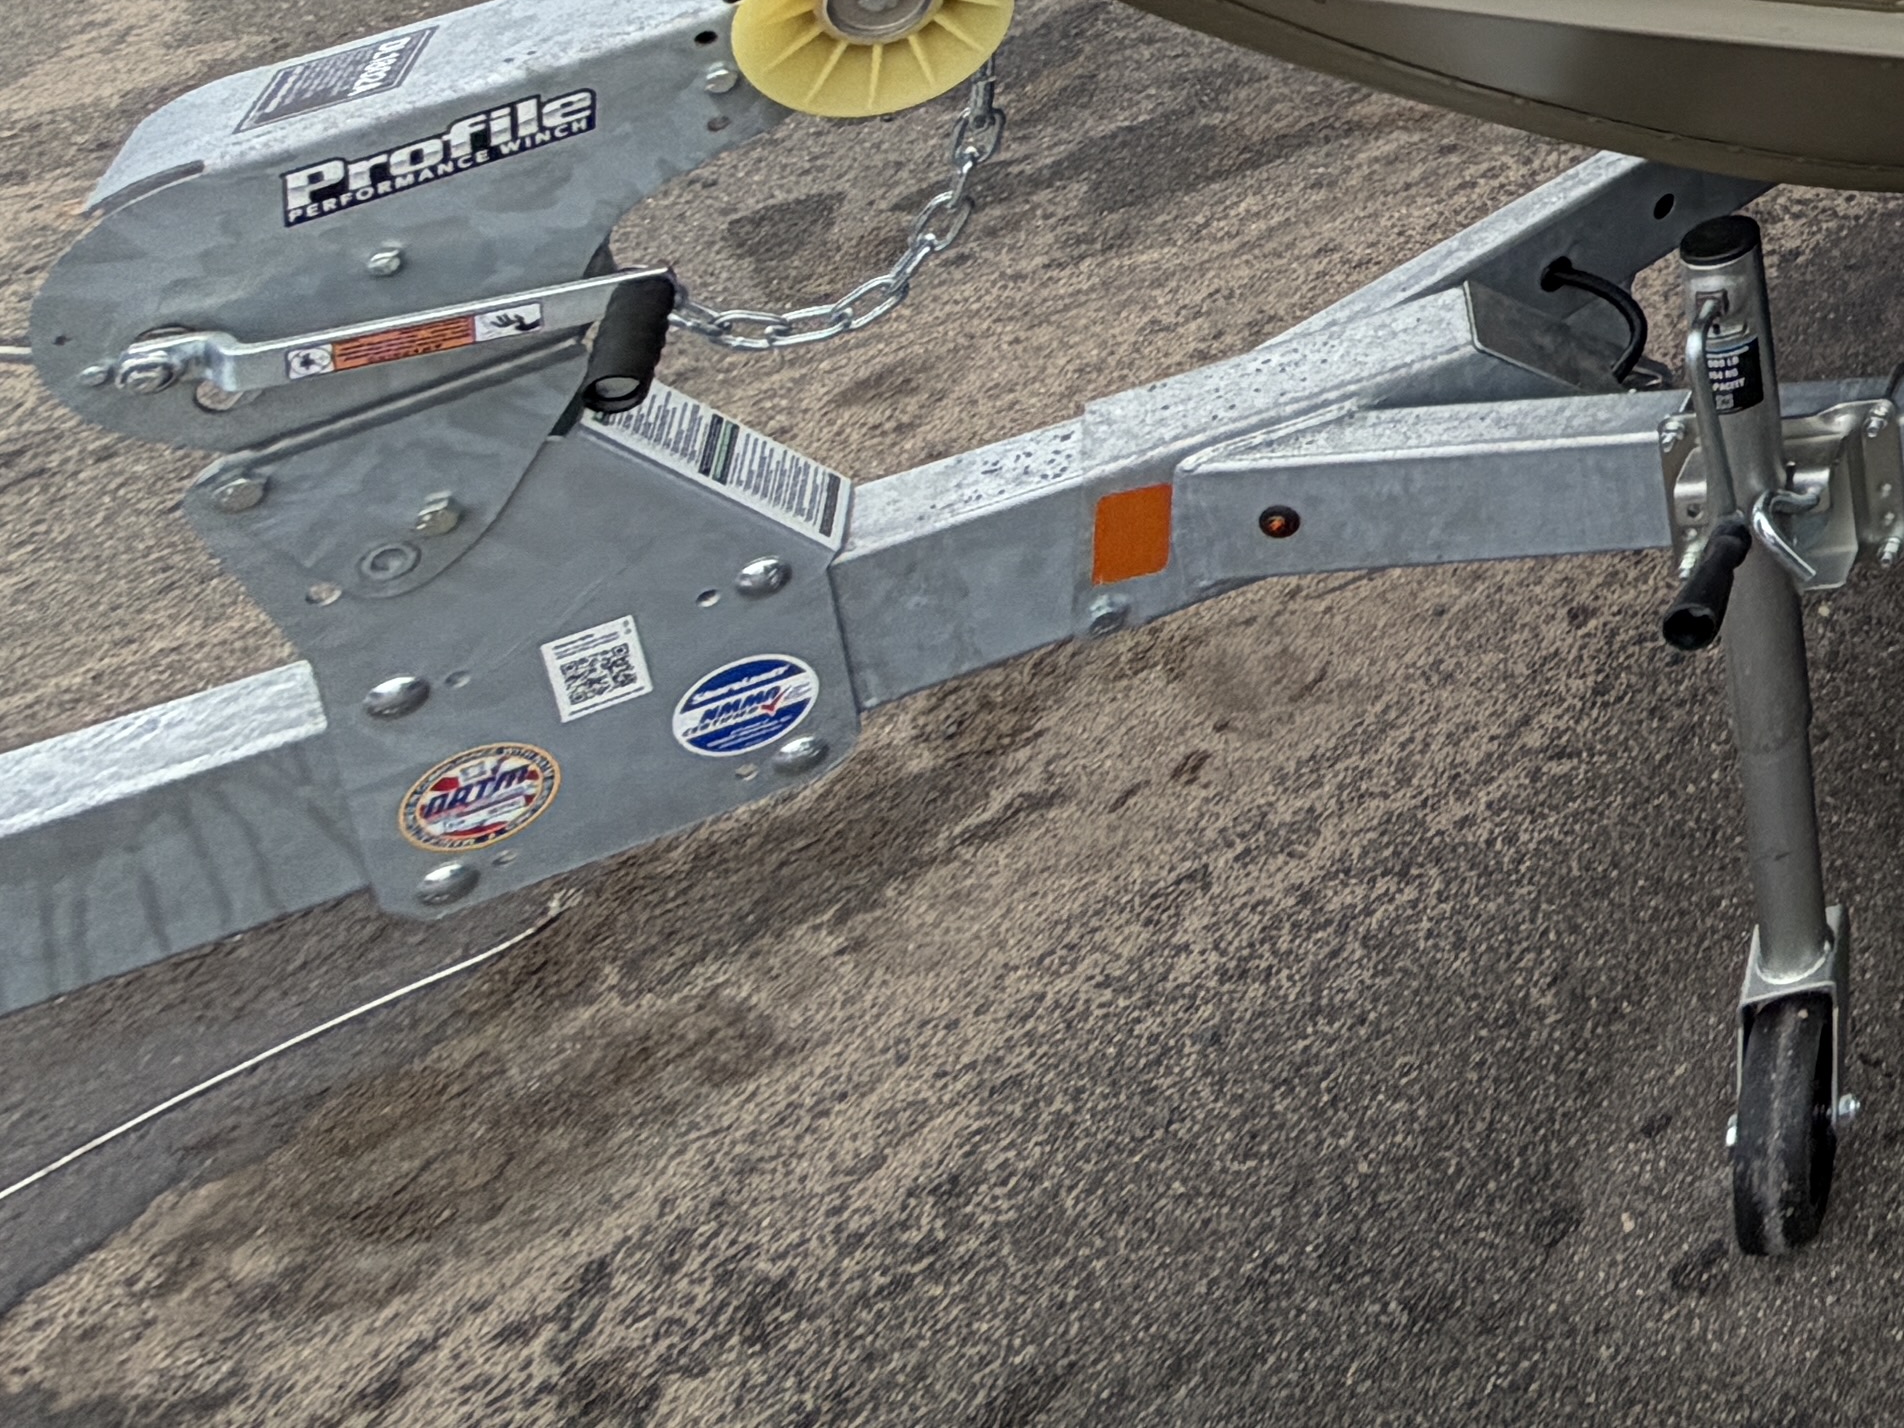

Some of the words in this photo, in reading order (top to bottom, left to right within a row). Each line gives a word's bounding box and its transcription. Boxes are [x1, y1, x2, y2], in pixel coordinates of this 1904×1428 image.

[286, 90, 593, 210] Profile
[287, 149, 490, 223] PERFORMANCE
[499, 118, 588, 155] WINCH
